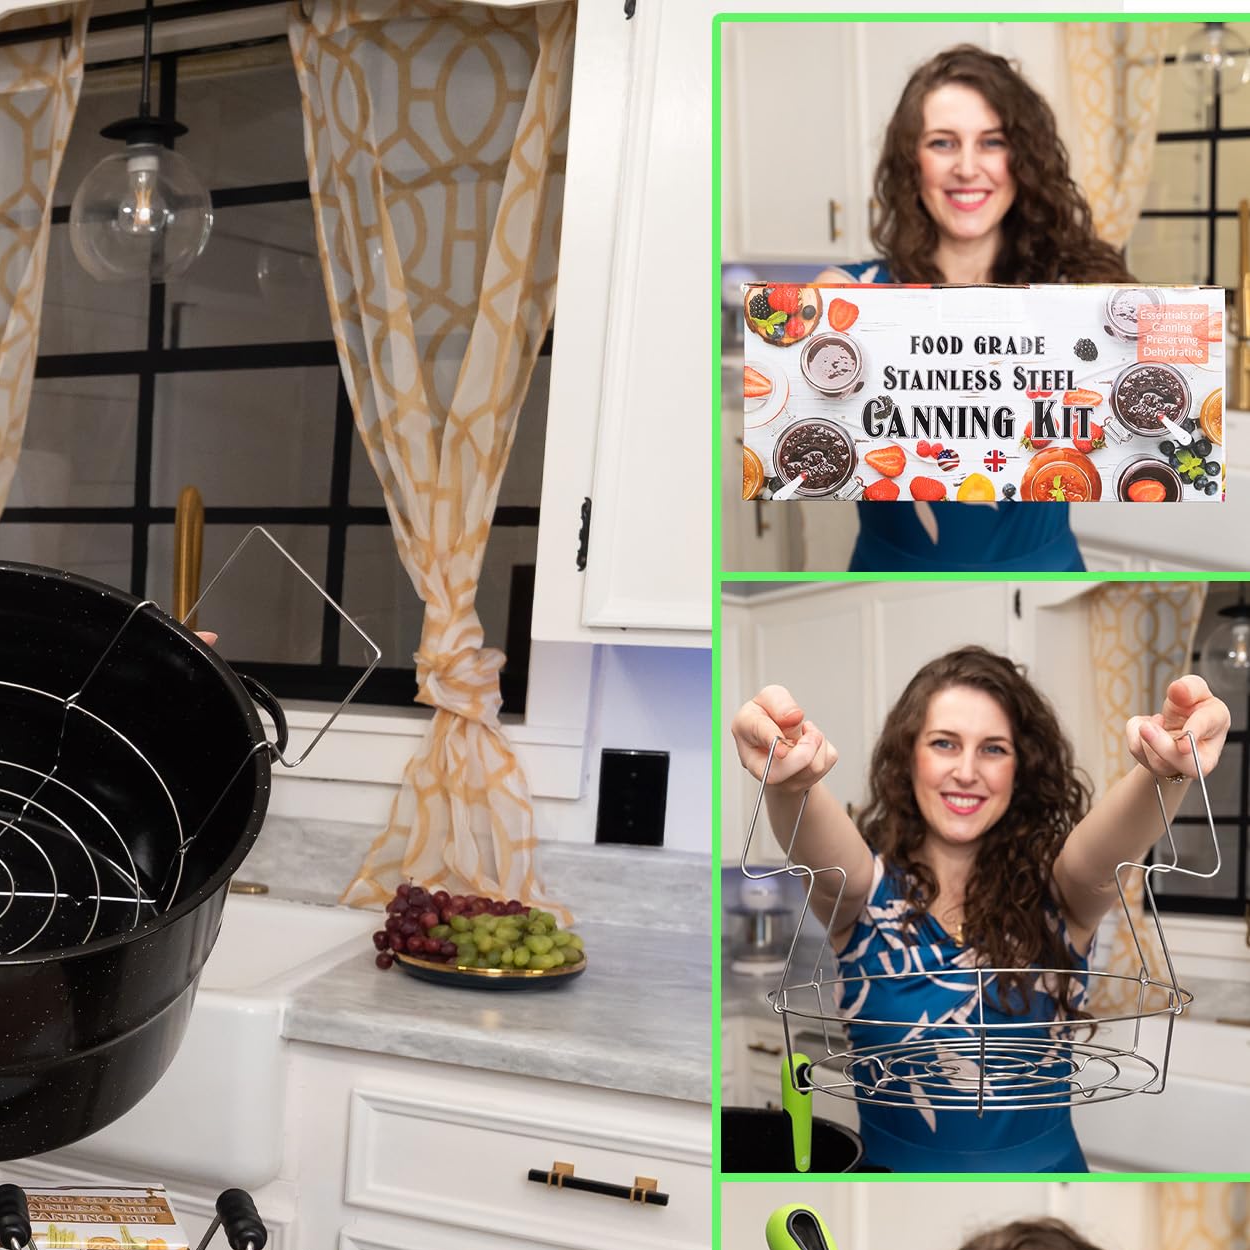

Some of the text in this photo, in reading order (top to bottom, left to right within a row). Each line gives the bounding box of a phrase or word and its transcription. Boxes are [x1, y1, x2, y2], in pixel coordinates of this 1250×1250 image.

[1140, 310, 1204, 320] Essentials for
[1152, 322, 1192, 333] Canning
[910, 335, 1046, 356] FOOD GRADE
[1146, 335, 1199, 346] Preserving
[1143, 347, 1203, 359] Dehydrating
[883, 365, 1078, 392] STAINLESS STEEL
[861, 398, 1095, 440] CANNING KIT
